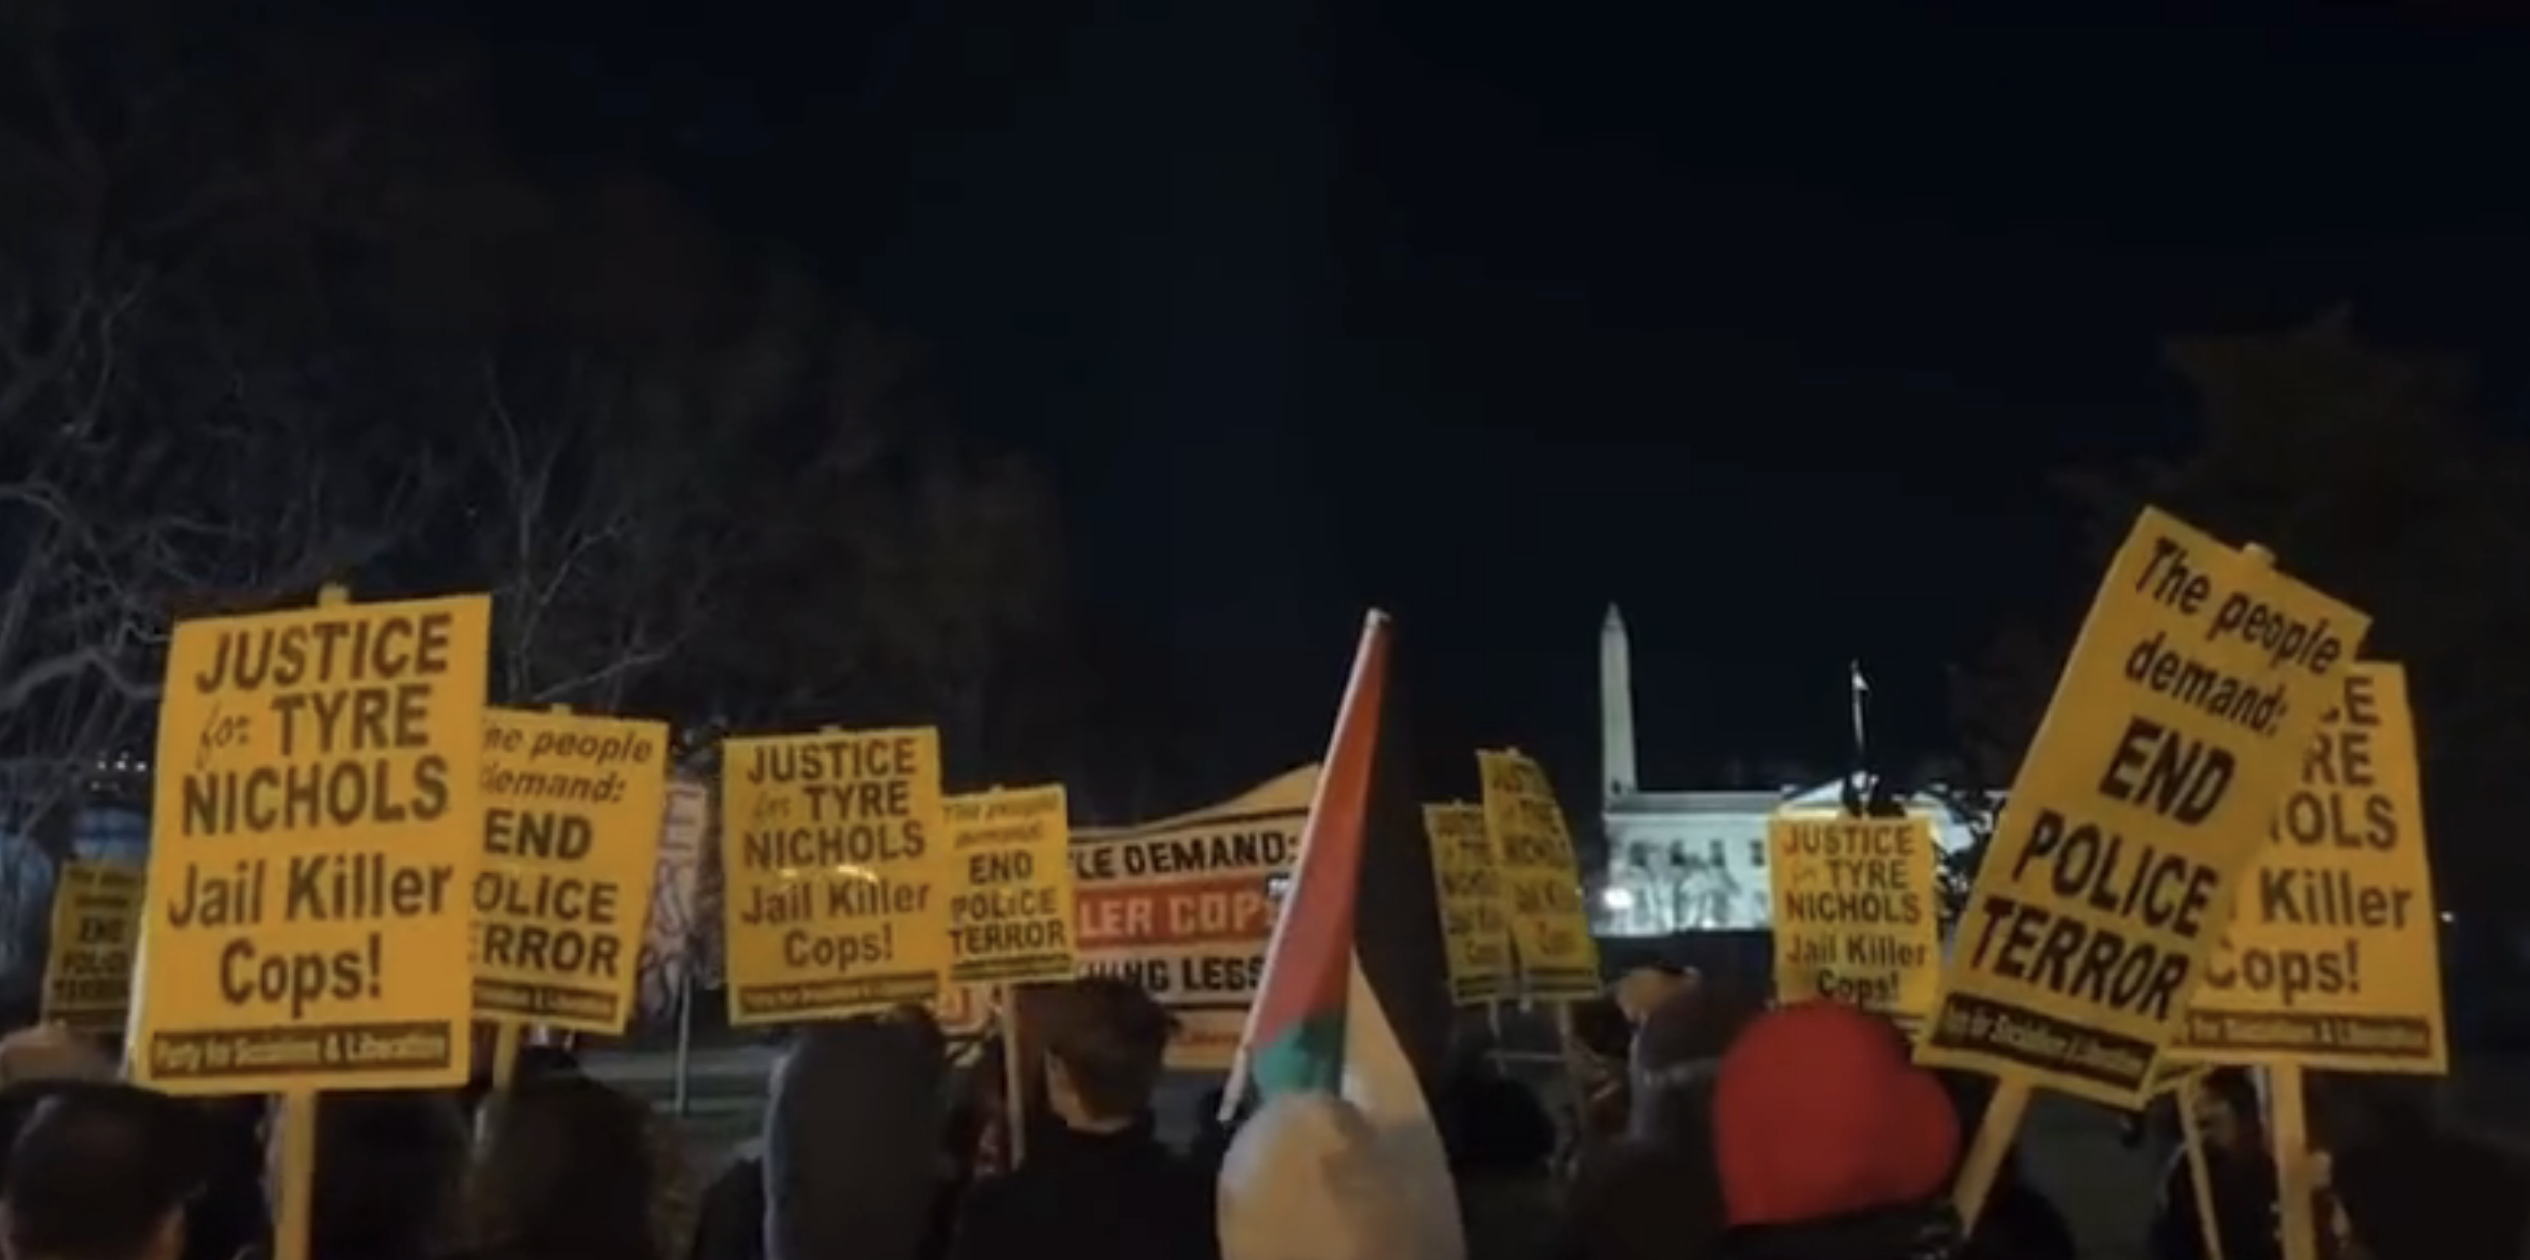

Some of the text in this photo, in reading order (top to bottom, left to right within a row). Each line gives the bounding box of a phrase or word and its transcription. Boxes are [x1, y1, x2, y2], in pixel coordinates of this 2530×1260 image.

[2136, 536, 2342, 675] The people
[196, 613, 453, 694] JUSTICE
[2125, 631, 2288, 738] demand:
[270, 682, 431, 757] TYRE
[531, 728, 654, 765] people
[748, 737, 917, 785] JUSTICE
[2098, 715, 2236, 826] END
[2303, 732, 2376, 787] RE
[183, 754, 450, 837] NICHOLS
[803, 781, 911, 822] TYRE
[484, 807, 592, 860] END
[744, 820, 926, 869] NICHOLS
[1783, 824, 1916, 857] JUSTICE
[2270, 792, 2398, 850] OLS
[969, 851, 1033, 884] END
[1124, 832, 1299, 876] DEMAND:
[1828, 858, 1908, 890] TYRE
[2011, 807, 2219, 938] POLICE
[168, 852, 454, 930] Jail Killer
[473, 871, 618, 924] OLICE
[741, 878, 930, 925] Jail Killer
[950, 887, 1057, 924] POLICE
[1786, 890, 1922, 925] NICHOLS
[2259, 867, 2413, 932] Killer
[784, 922, 893, 972] Cops!
[947, 920, 1067, 956] TERROR
[1787, 932, 1927, 967] Jail Killer
[1970, 895, 2189, 1023] TERROR
[220, 932, 382, 1020] Cops!
[1818, 968, 1899, 1009] Cops!
[326, 1031, 341, 1062] &
